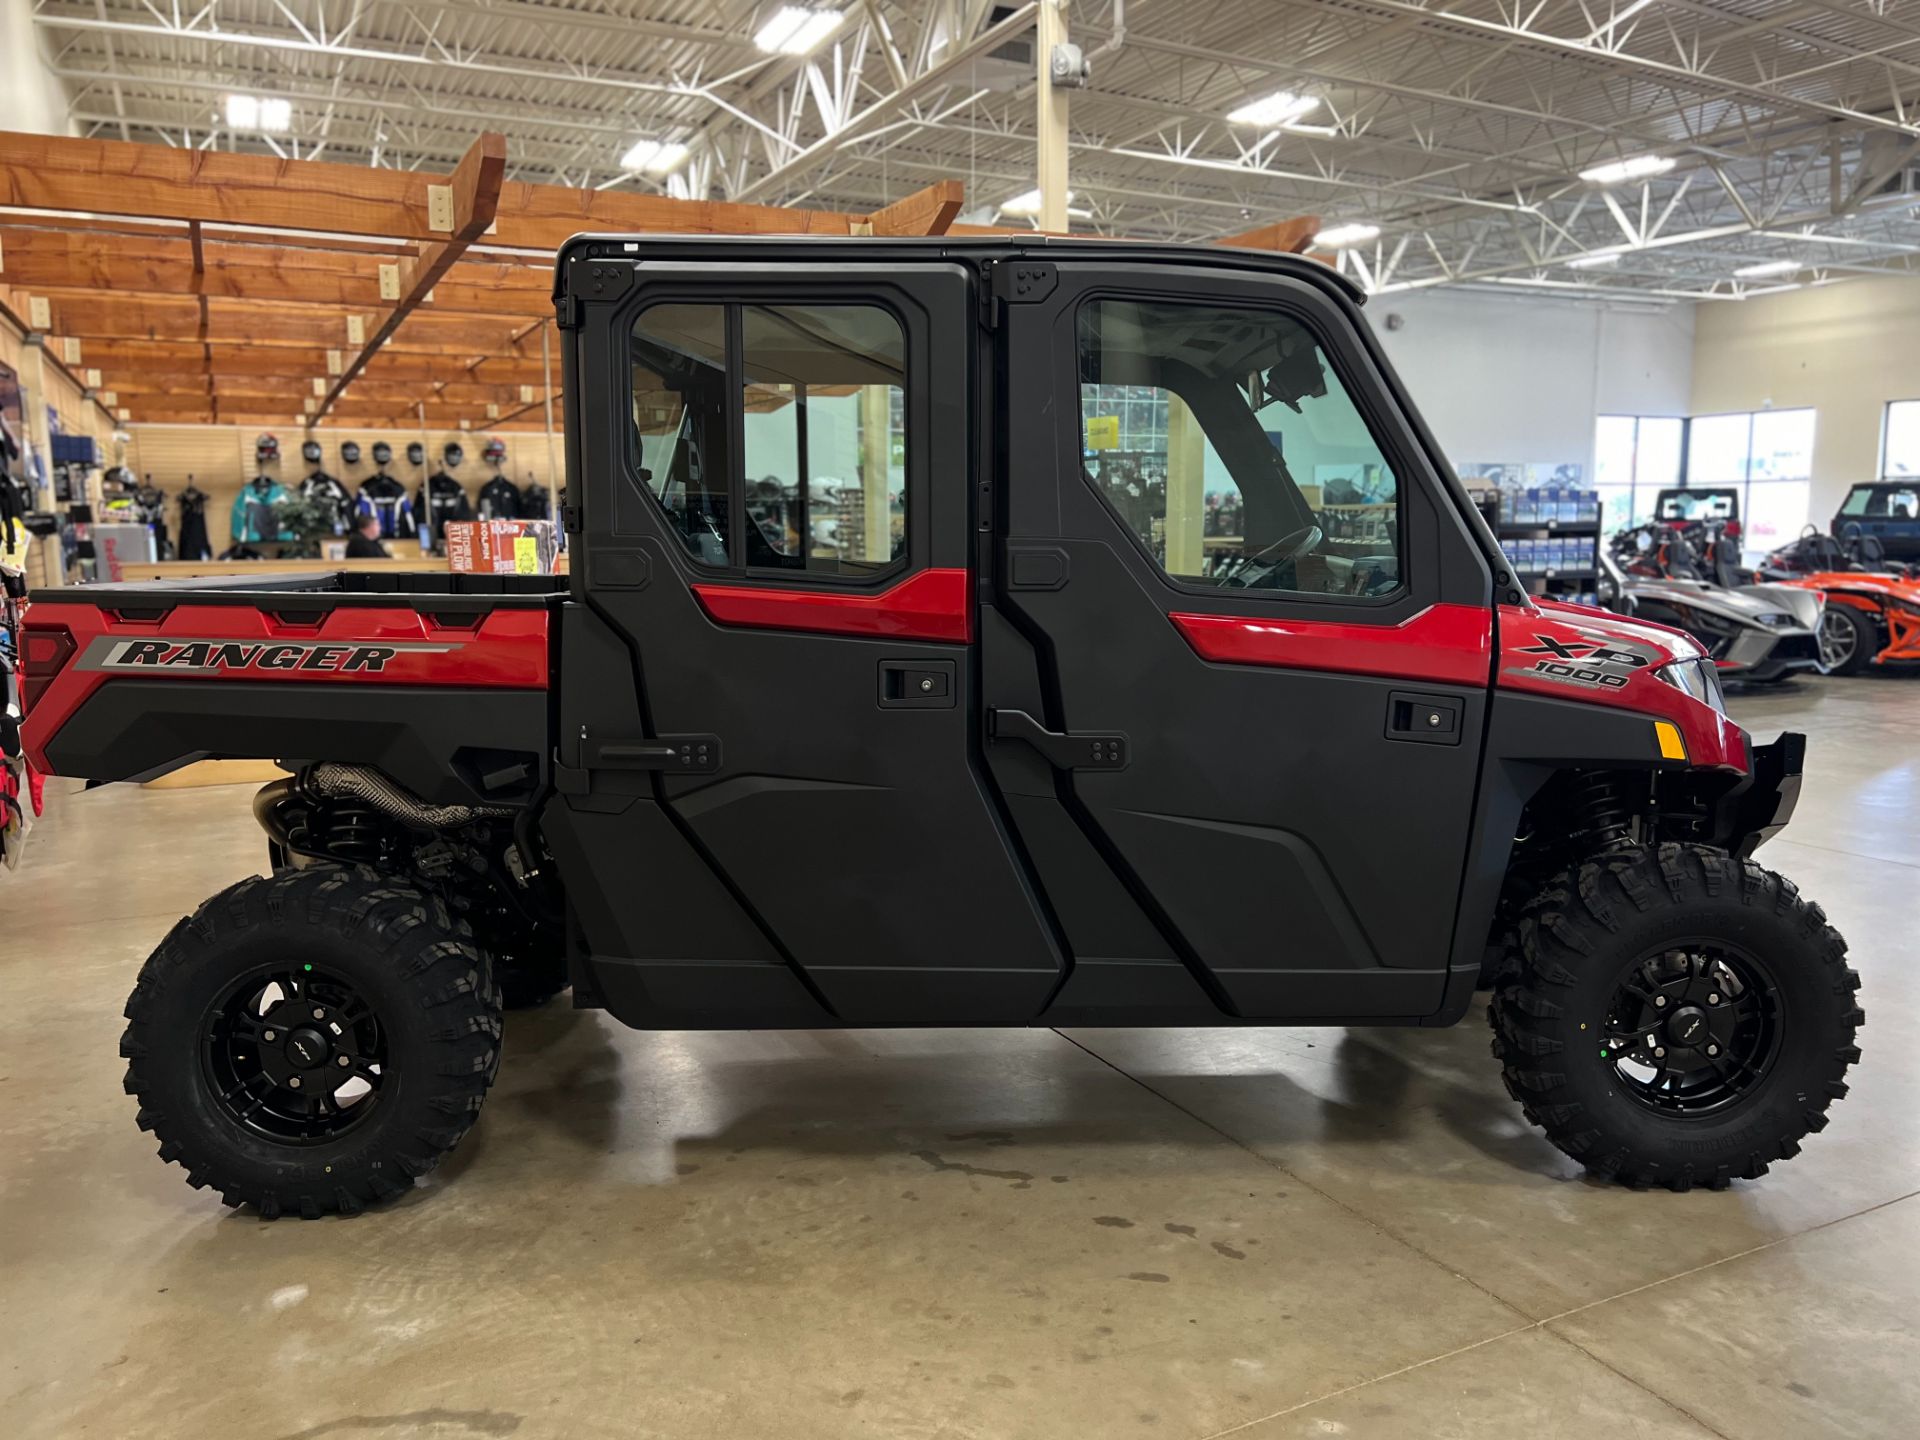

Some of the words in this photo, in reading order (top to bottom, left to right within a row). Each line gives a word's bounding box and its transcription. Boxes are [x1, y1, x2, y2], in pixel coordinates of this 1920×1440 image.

[480, 523, 490, 560] KOLPIN
[452, 545, 464, 571] PLOW
[116, 640, 395, 672] RANGER
[1507, 632, 1650, 668] XP
[1534, 659, 1630, 689] 1000
